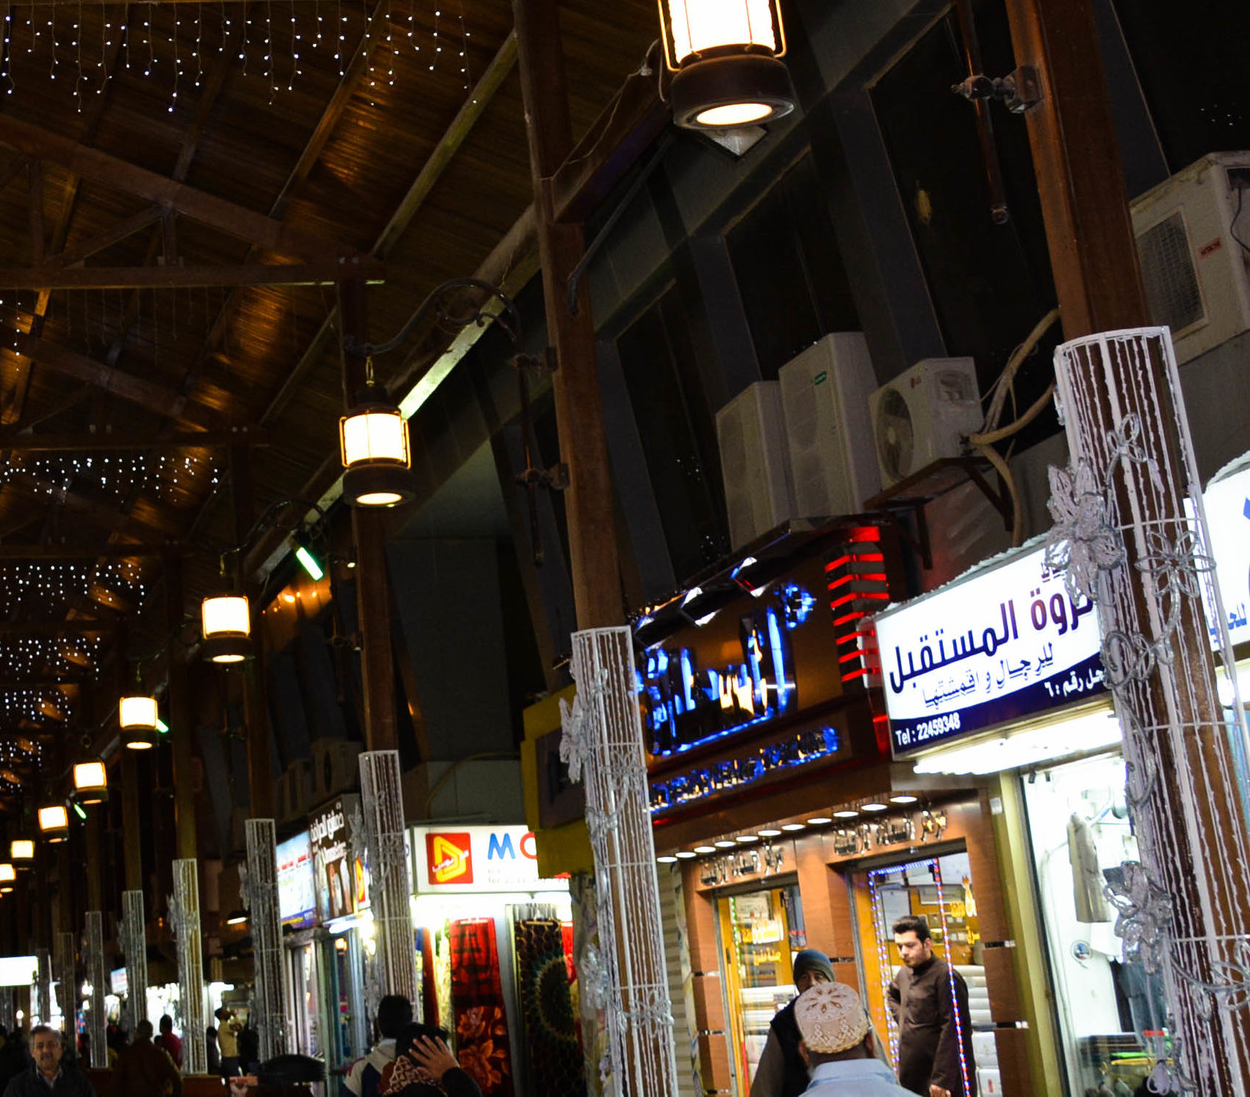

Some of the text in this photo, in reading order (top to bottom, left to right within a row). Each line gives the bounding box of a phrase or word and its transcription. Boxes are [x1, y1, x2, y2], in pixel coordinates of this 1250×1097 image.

[889, 600, 1018, 694] المستقبل
[1063, 670, 1084, 697] رقم
[895, 730, 911, 745] Tel
[916, 711, 961, 741] 22459348
